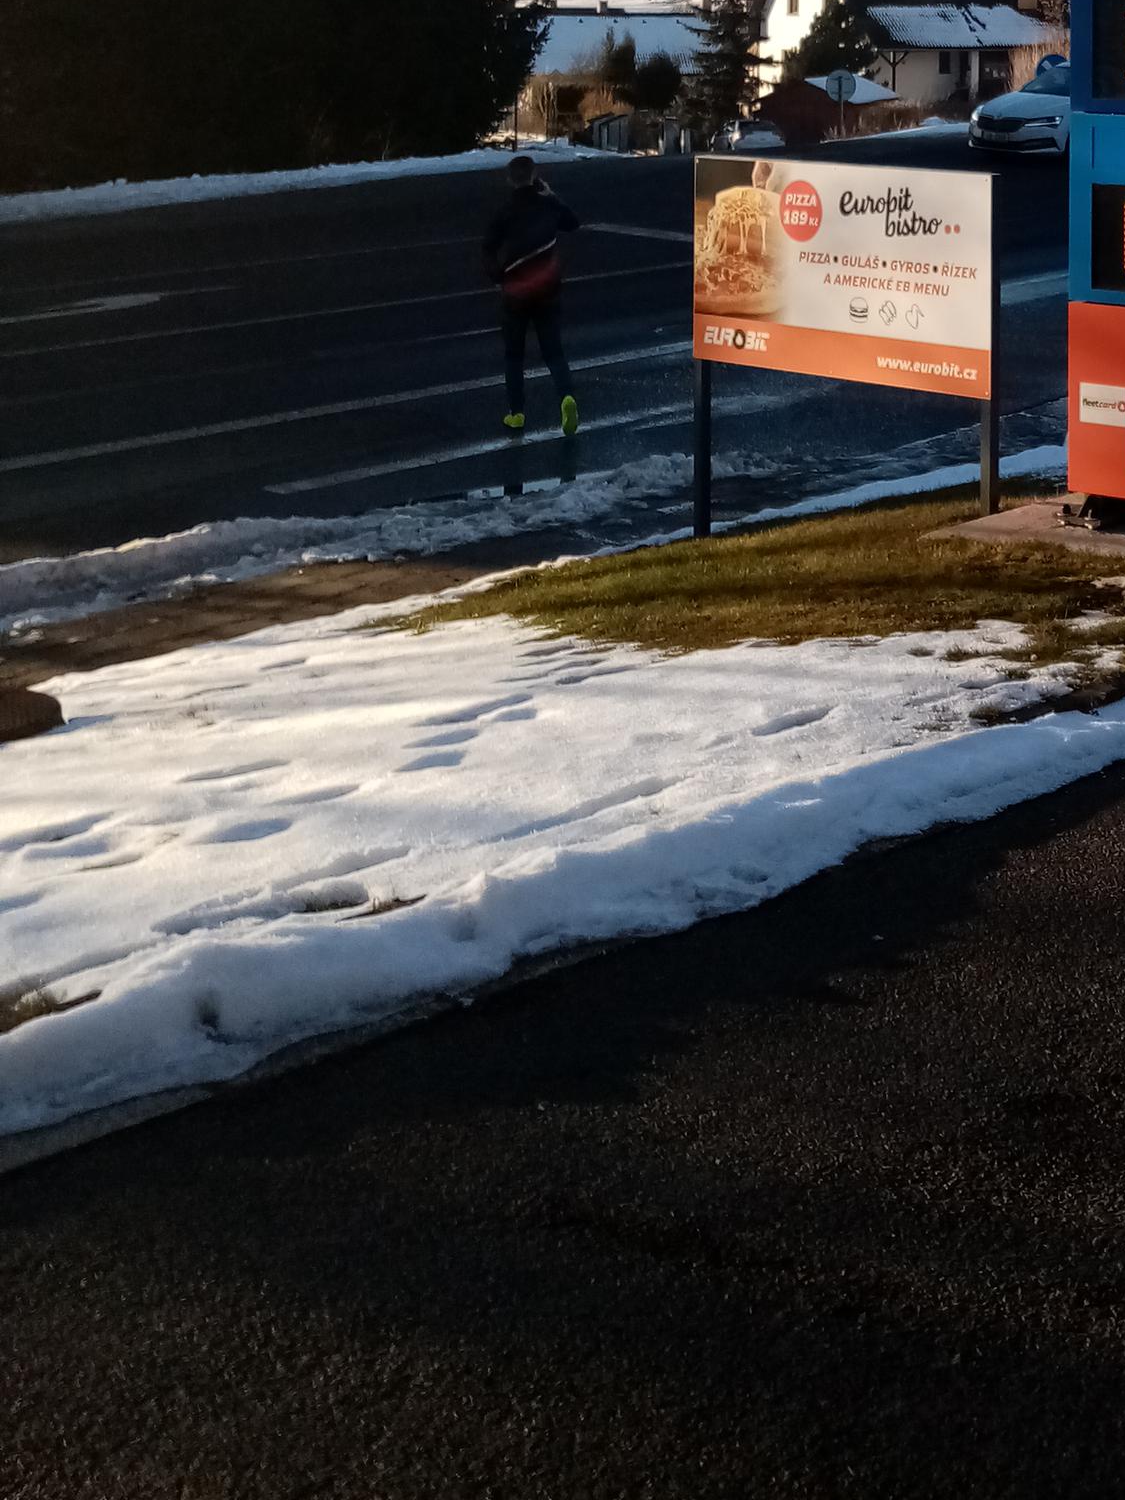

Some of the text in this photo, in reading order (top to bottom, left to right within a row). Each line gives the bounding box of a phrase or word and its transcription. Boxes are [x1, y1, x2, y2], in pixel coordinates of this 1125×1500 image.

[785, 193, 817, 207] PIZZA
[783, 211, 808, 226] 189
[799, 251, 978, 280] PIZZA GULÁŠ GYROS ŘÍZEK
[833, 274, 893, 291] AMERICKÉ
[913, 282, 950, 297] MENU
[876, 356, 978, 381] www.eurobit.cz
